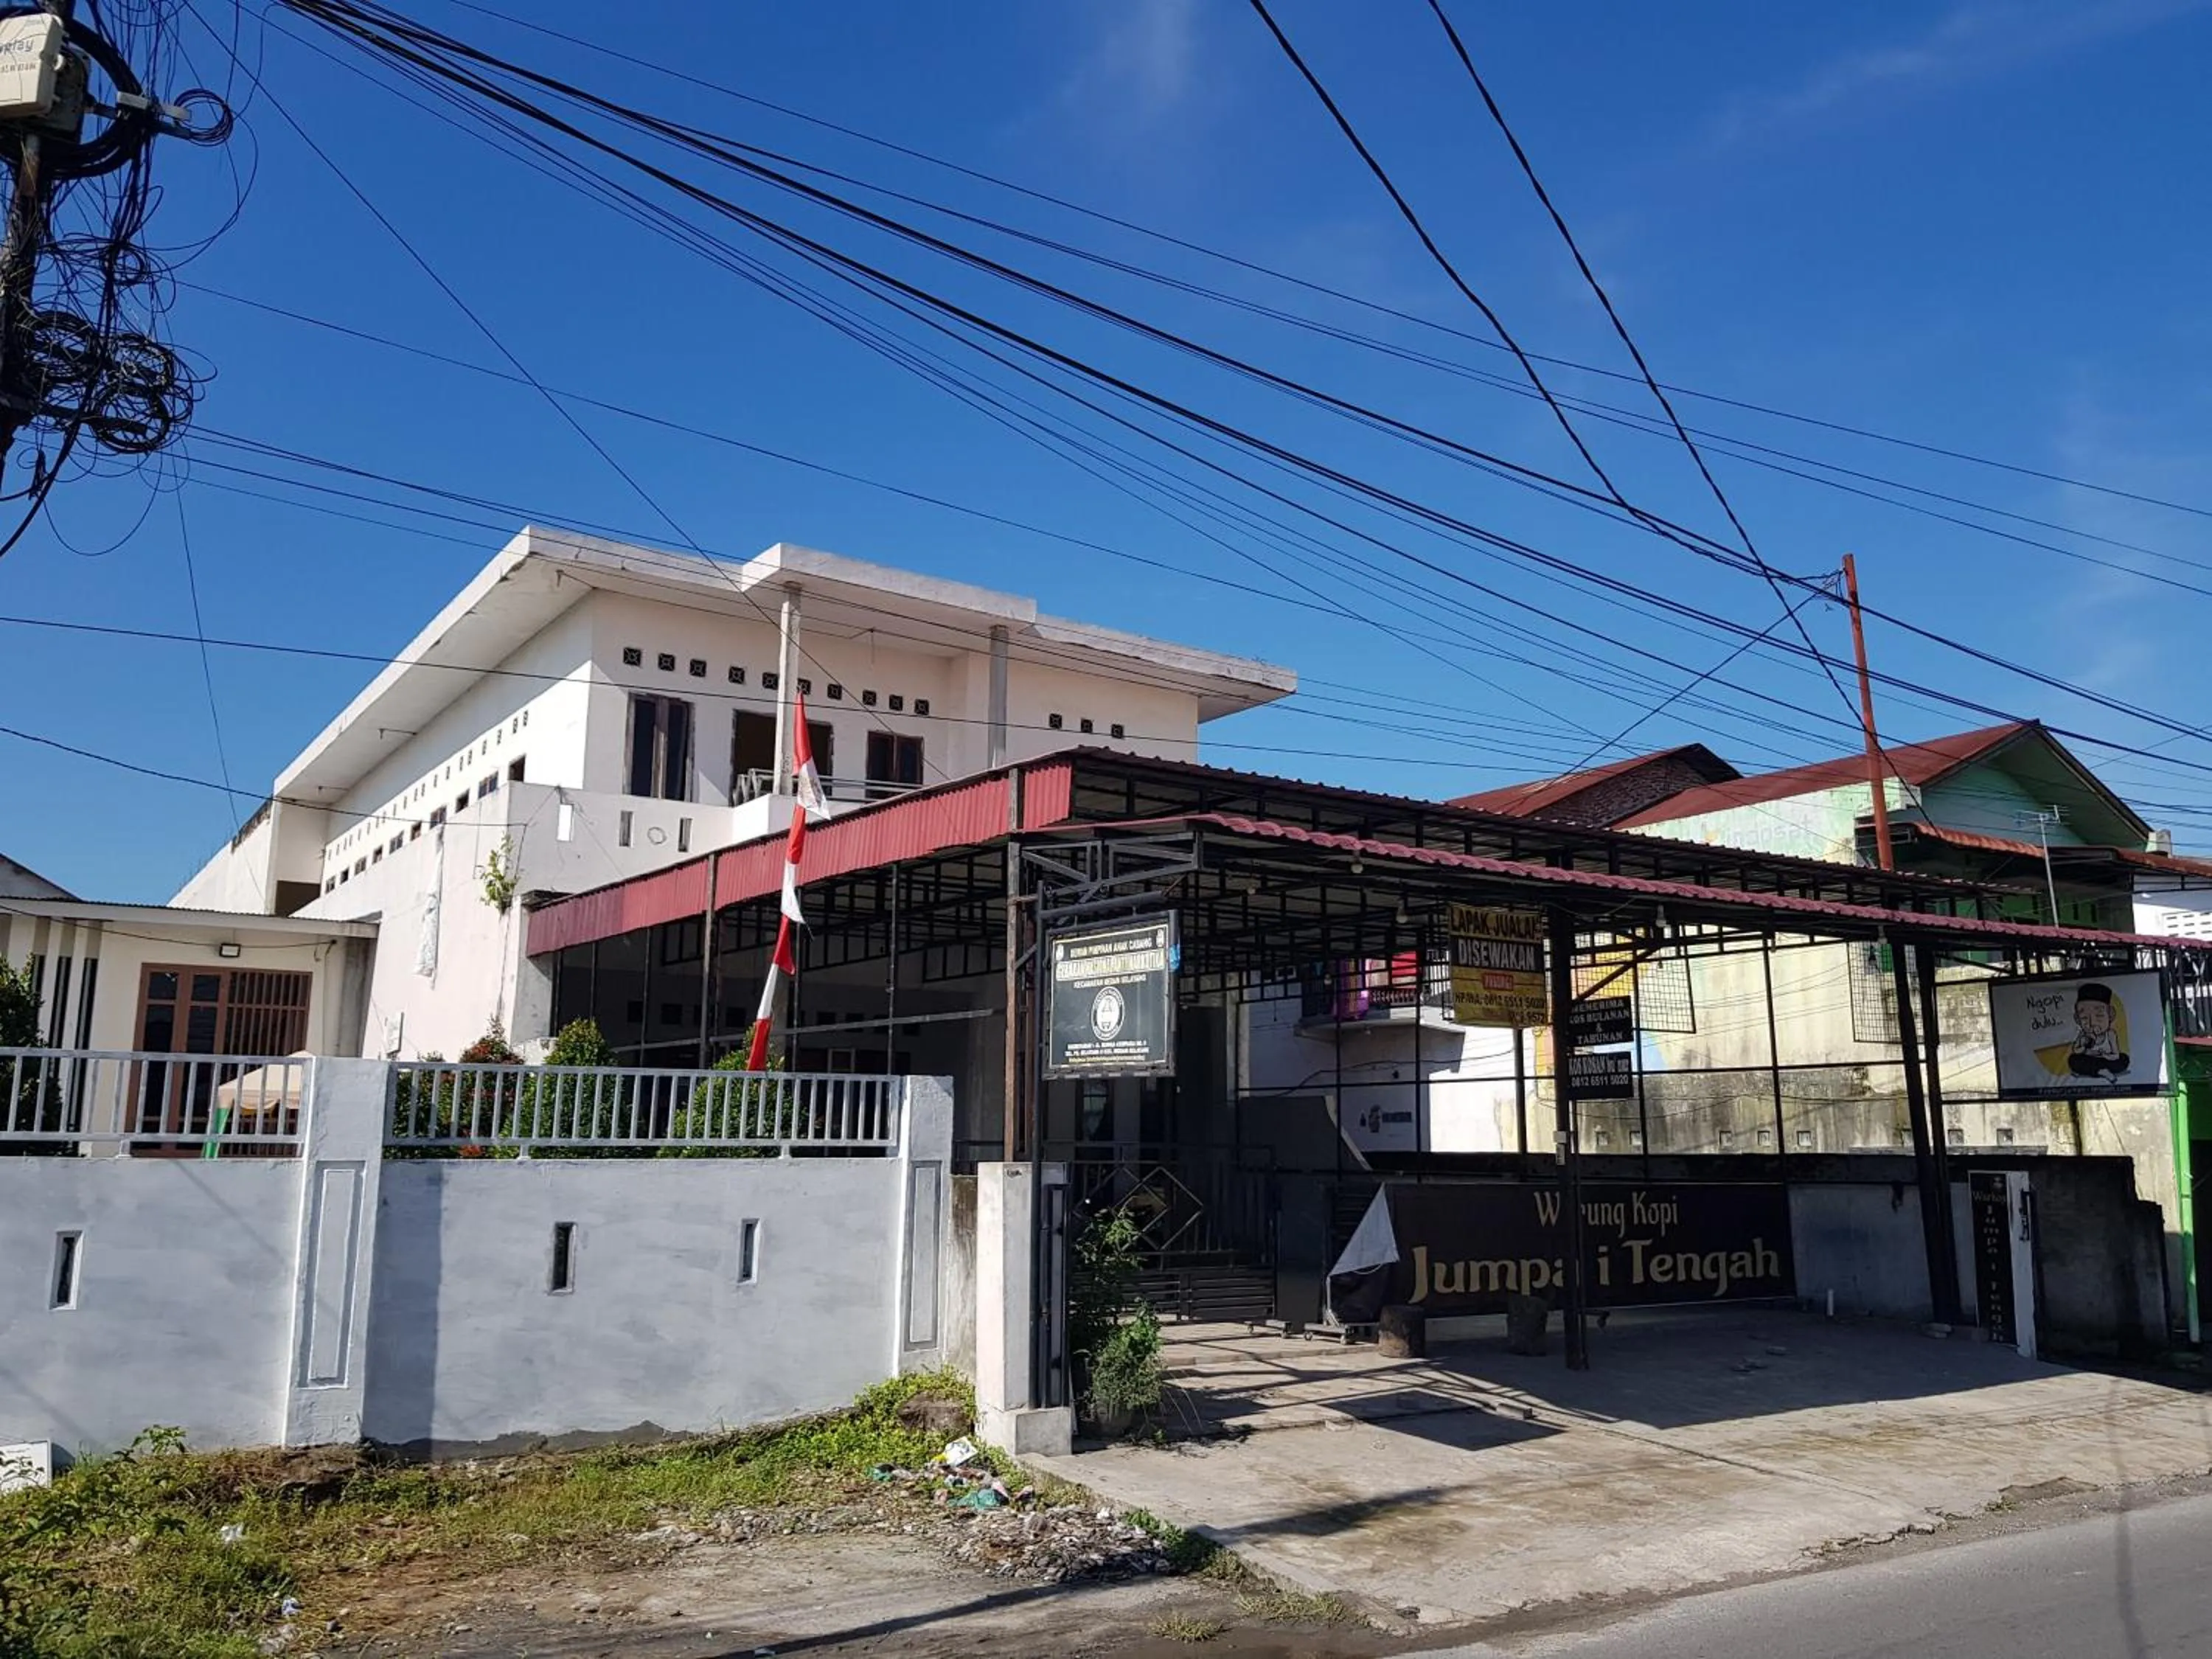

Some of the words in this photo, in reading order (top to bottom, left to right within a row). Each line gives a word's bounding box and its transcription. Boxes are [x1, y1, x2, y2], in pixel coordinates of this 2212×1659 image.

[1451, 905, 1490, 936] LAPAK
[1457, 938, 1535, 971] DISEWAKAN
[1586, 1008, 1630, 1023] BULANAN
[2026, 992, 2065, 1014] Ngopi
[1576, 1032, 1624, 1045] TAHUNAN
[1534, 1190, 1625, 1238] Wung
[1632, 1191, 1678, 1237] Kopi
[1621, 1237, 1781, 1297] Tengah
